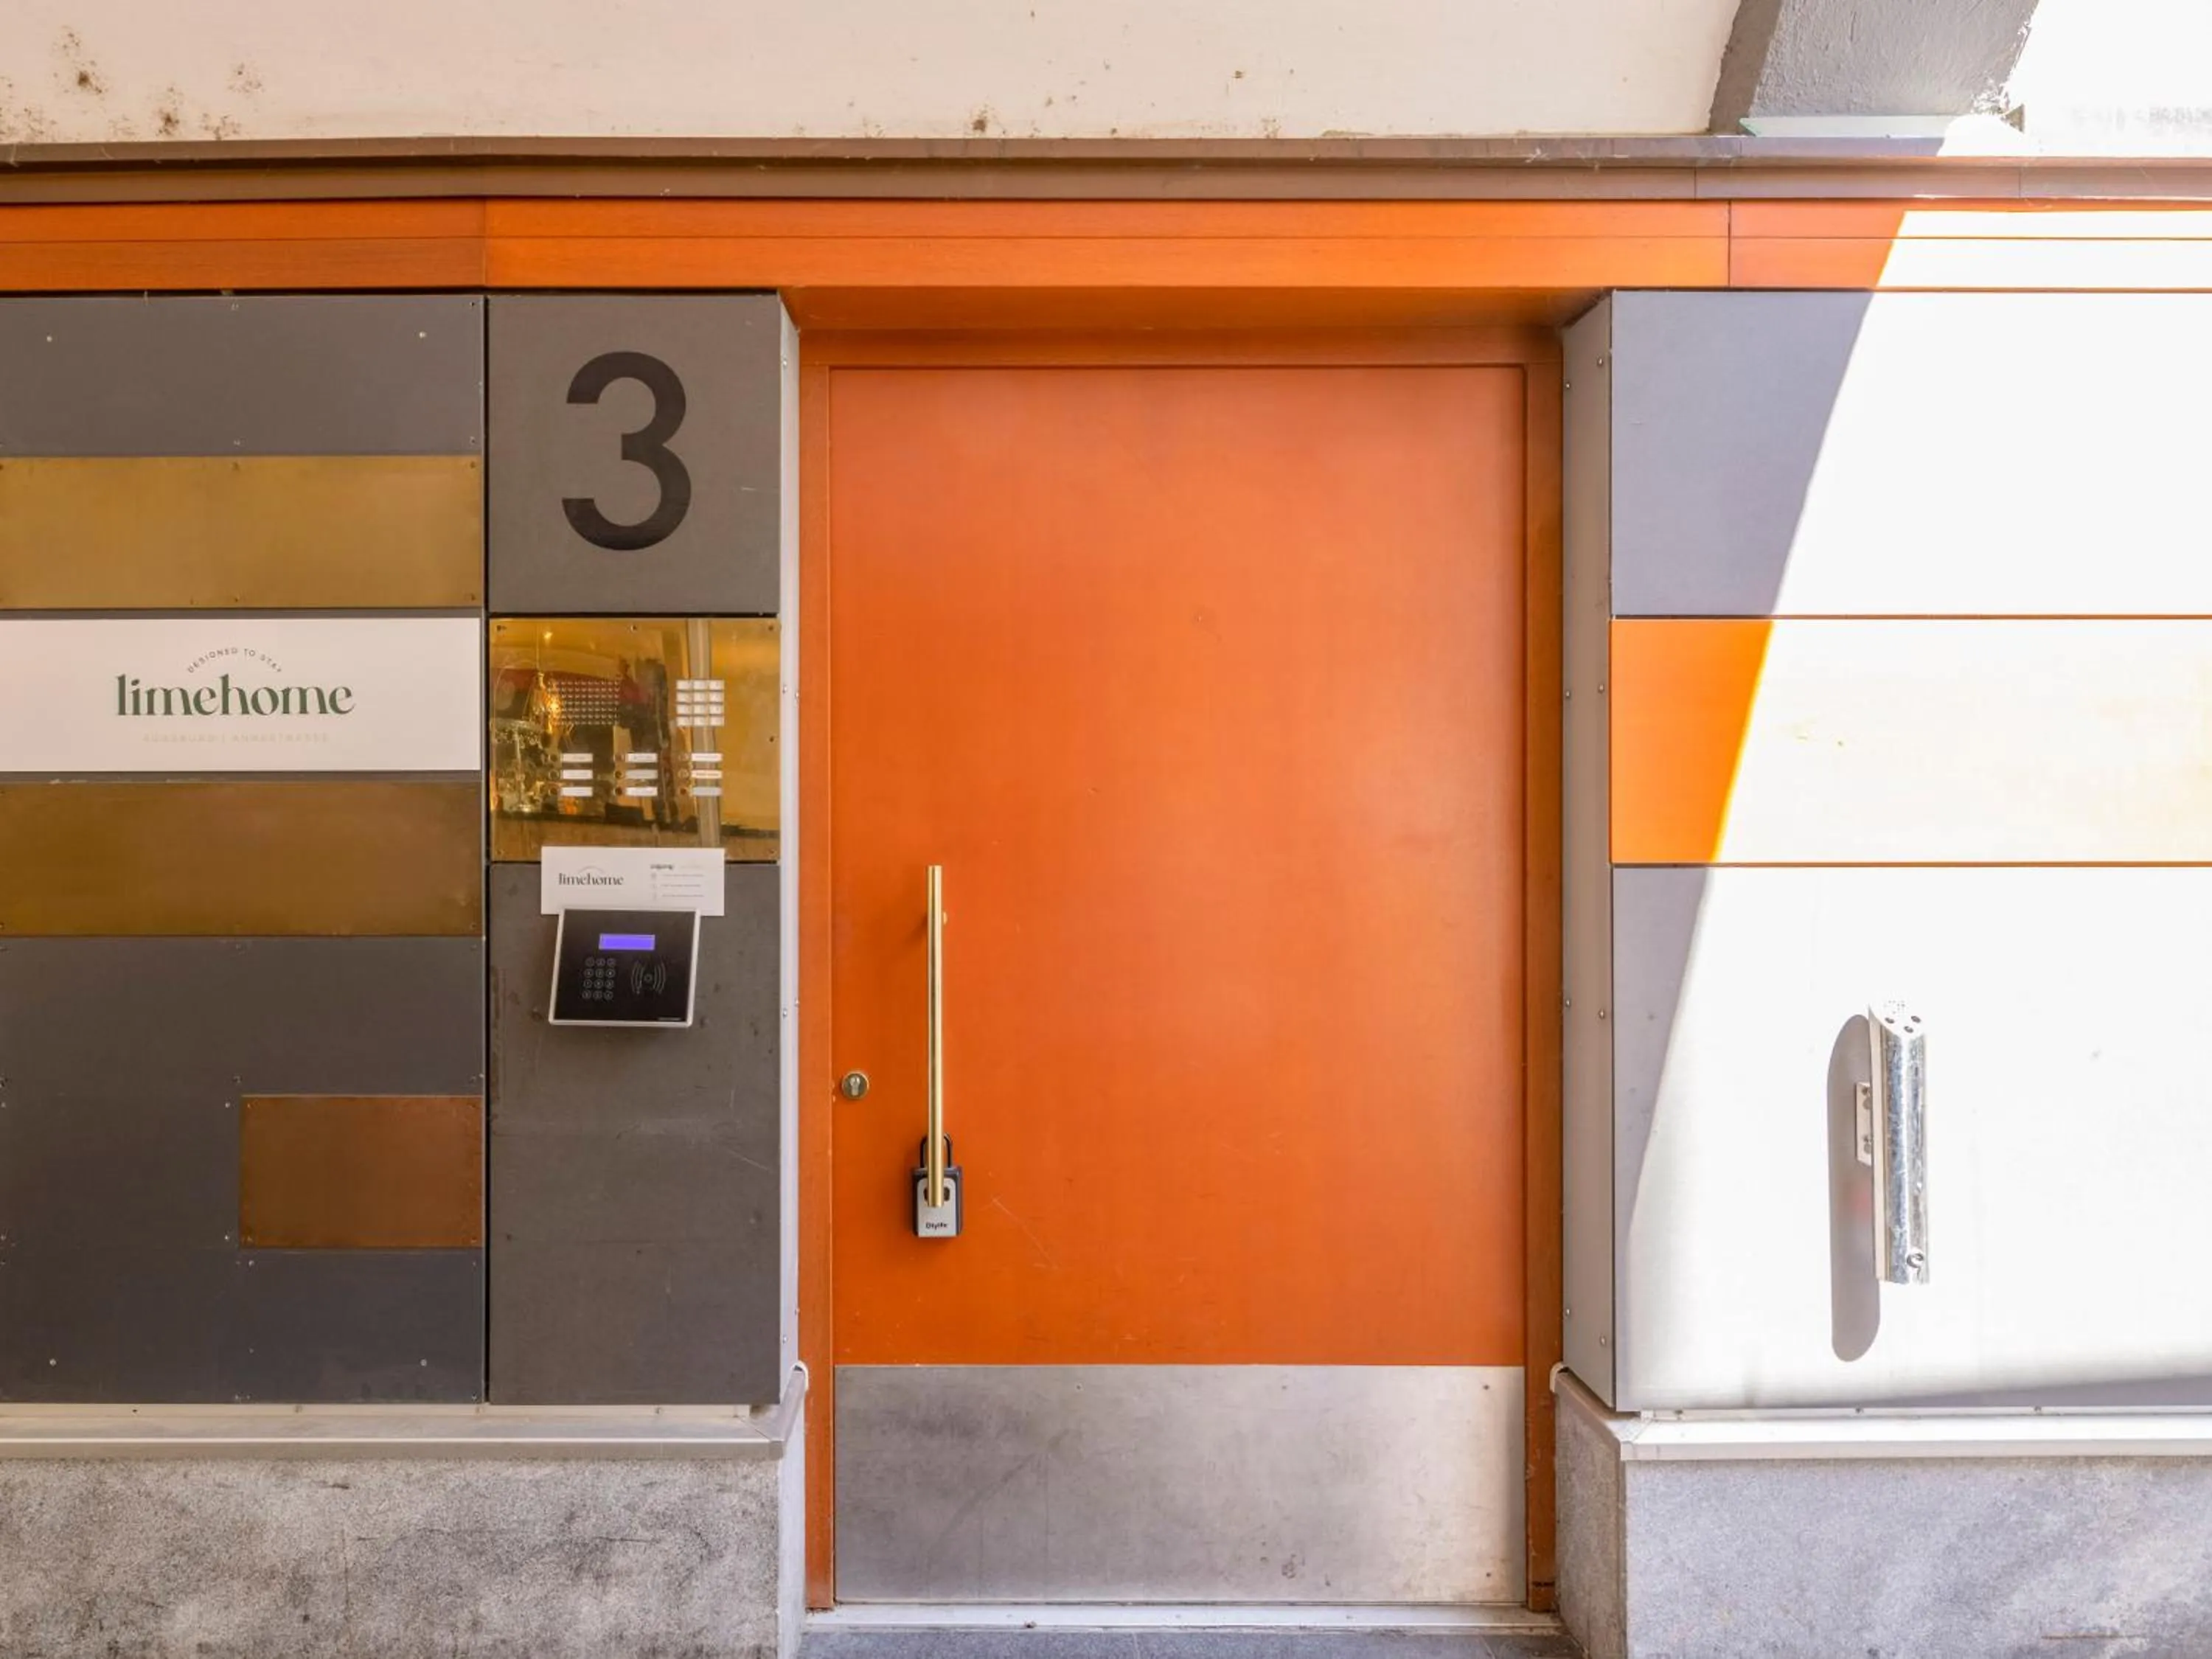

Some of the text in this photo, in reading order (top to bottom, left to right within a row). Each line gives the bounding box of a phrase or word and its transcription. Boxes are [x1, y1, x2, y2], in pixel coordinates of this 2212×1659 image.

[561, 351, 692, 551] 3
[243, 648, 256, 657] TO
[116, 674, 355, 715] limehome
[558, 872, 625, 886] limehome
